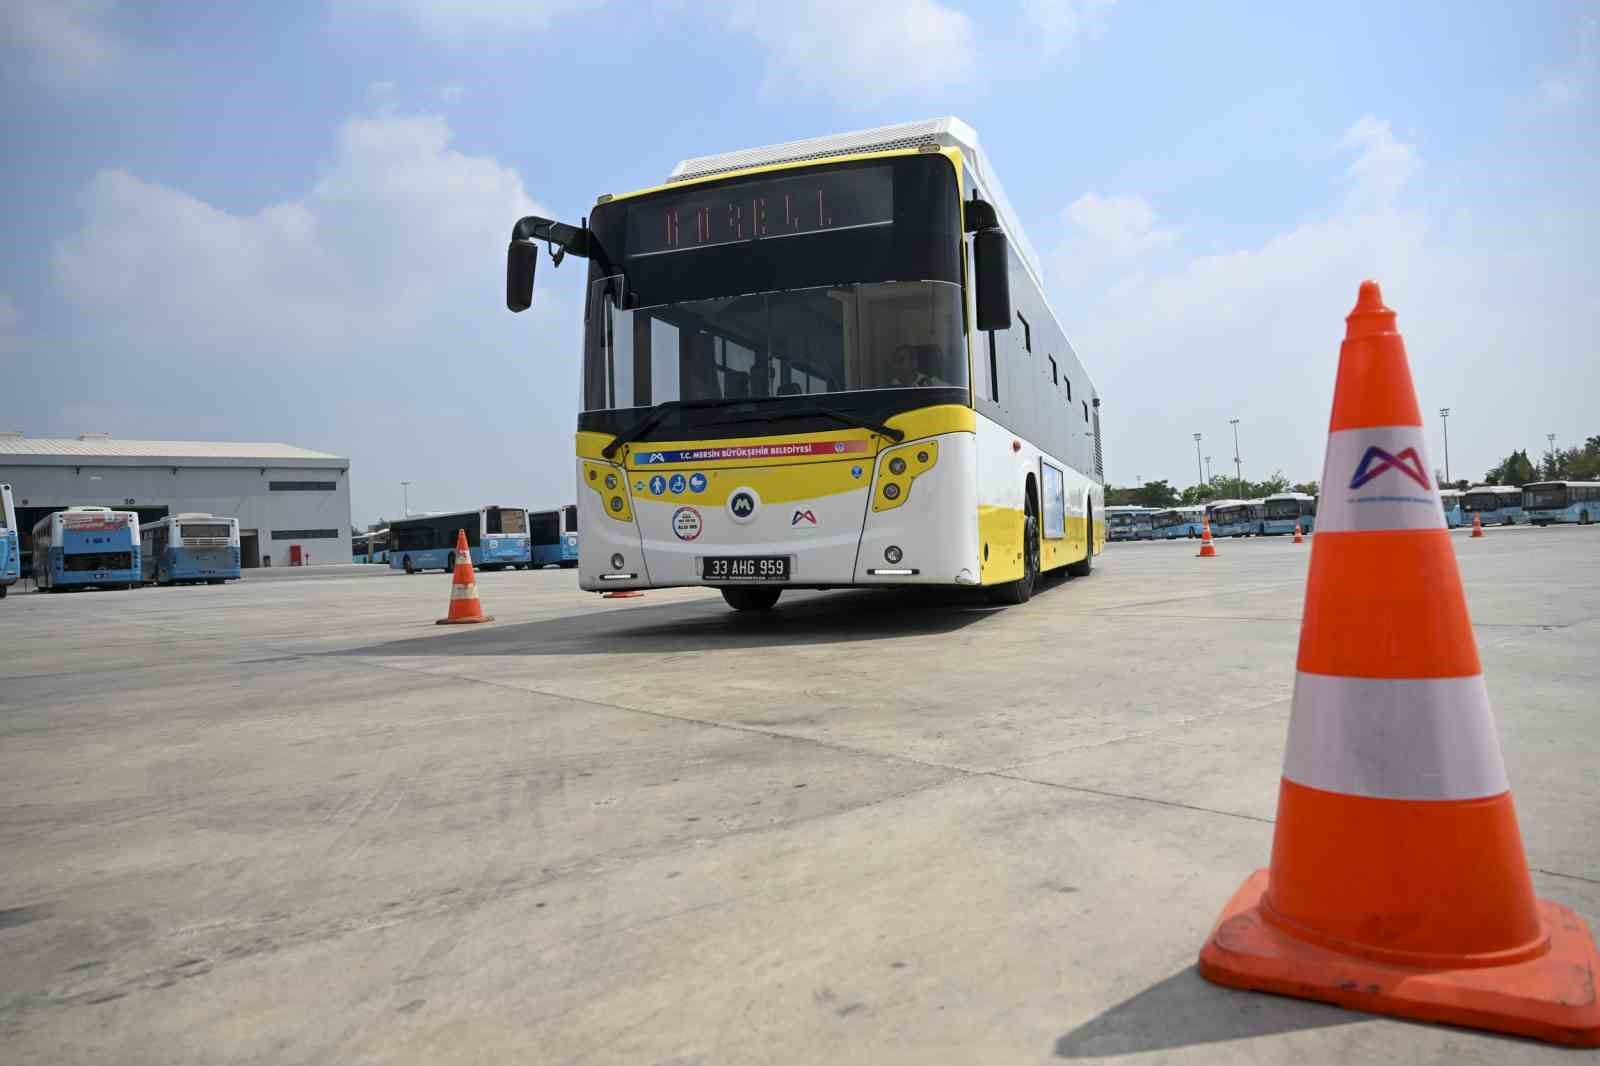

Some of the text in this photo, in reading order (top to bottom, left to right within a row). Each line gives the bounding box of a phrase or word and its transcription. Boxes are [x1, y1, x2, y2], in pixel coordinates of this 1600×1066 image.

[680, 443, 812, 460] T.C. MERSİN BÜYÜKŞEHİR BELEDİYESİ
[712, 559, 784, 575] 33 AHG 959
